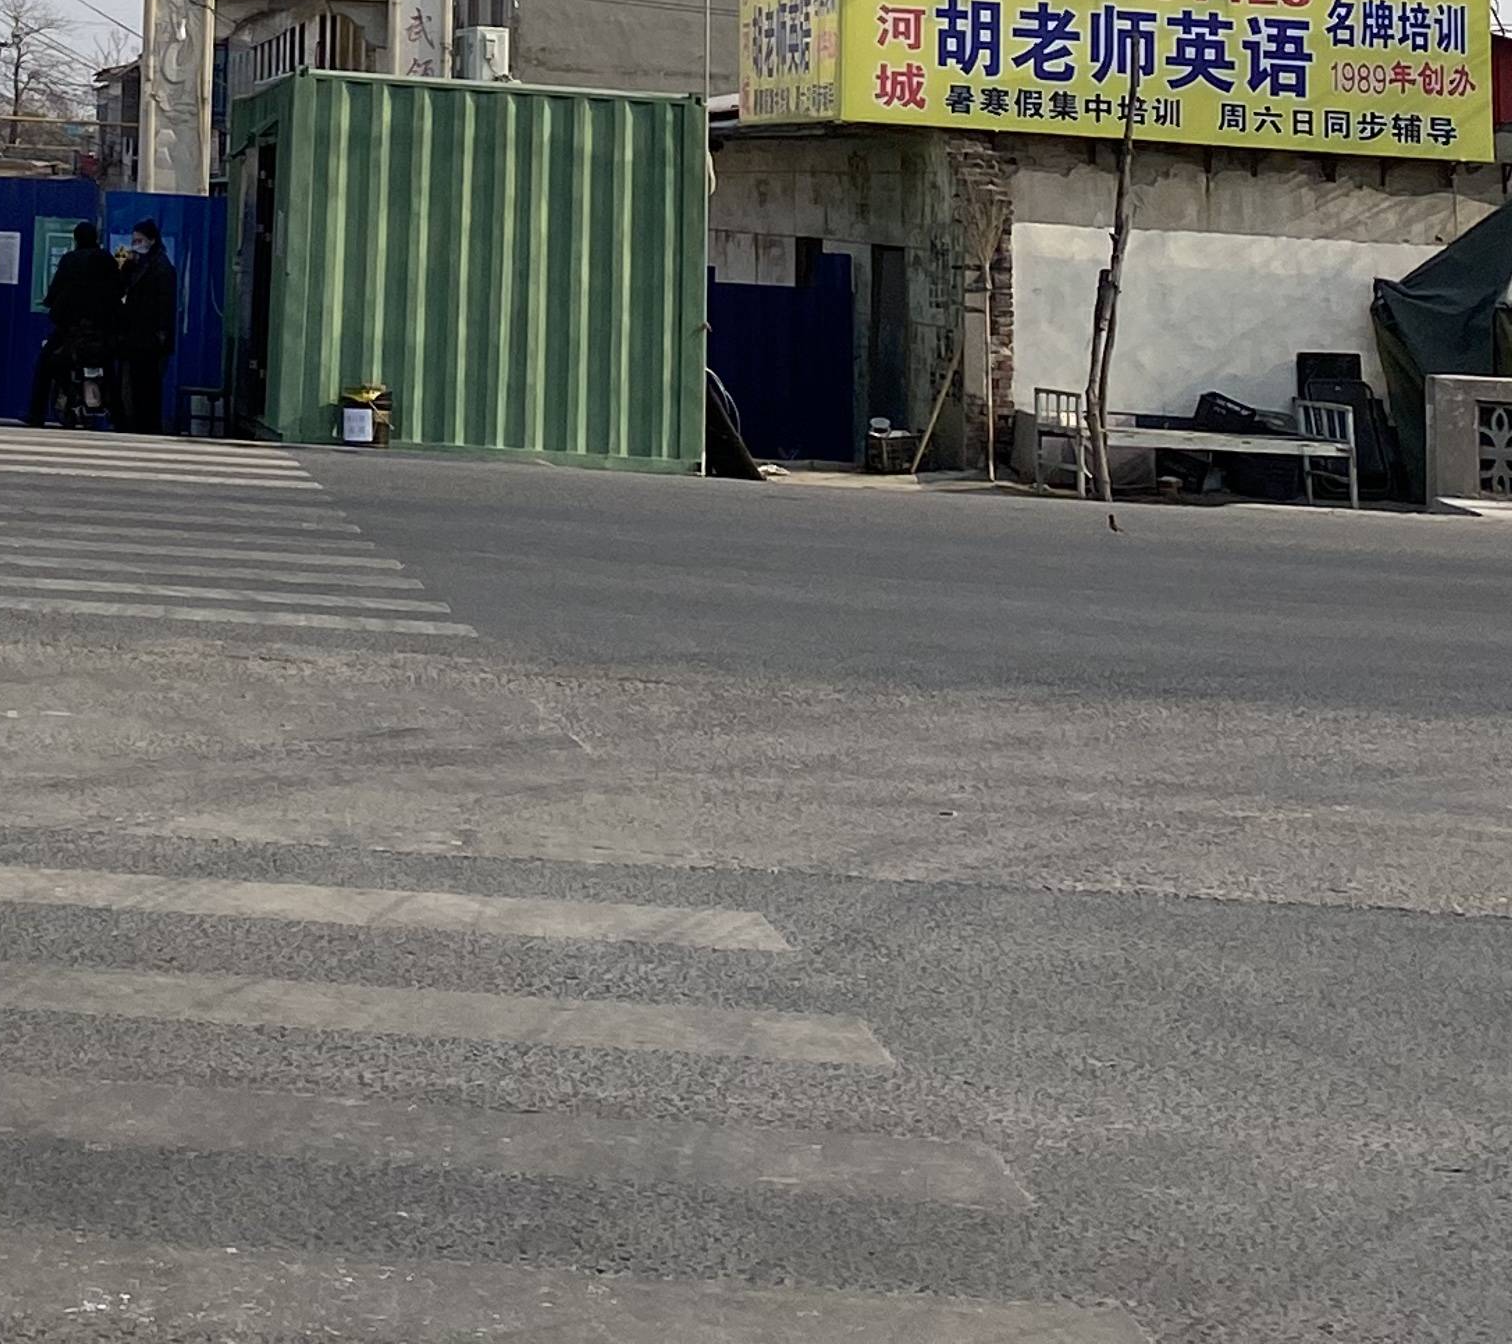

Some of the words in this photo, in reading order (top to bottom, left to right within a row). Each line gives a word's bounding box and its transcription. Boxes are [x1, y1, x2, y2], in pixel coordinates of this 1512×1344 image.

[1330, 60, 1477, 98] 1989年创办
[945, 84, 1182, 128] 暑寒假集中培训
[1218, 102, 1458, 146] 周六日同步辅导
